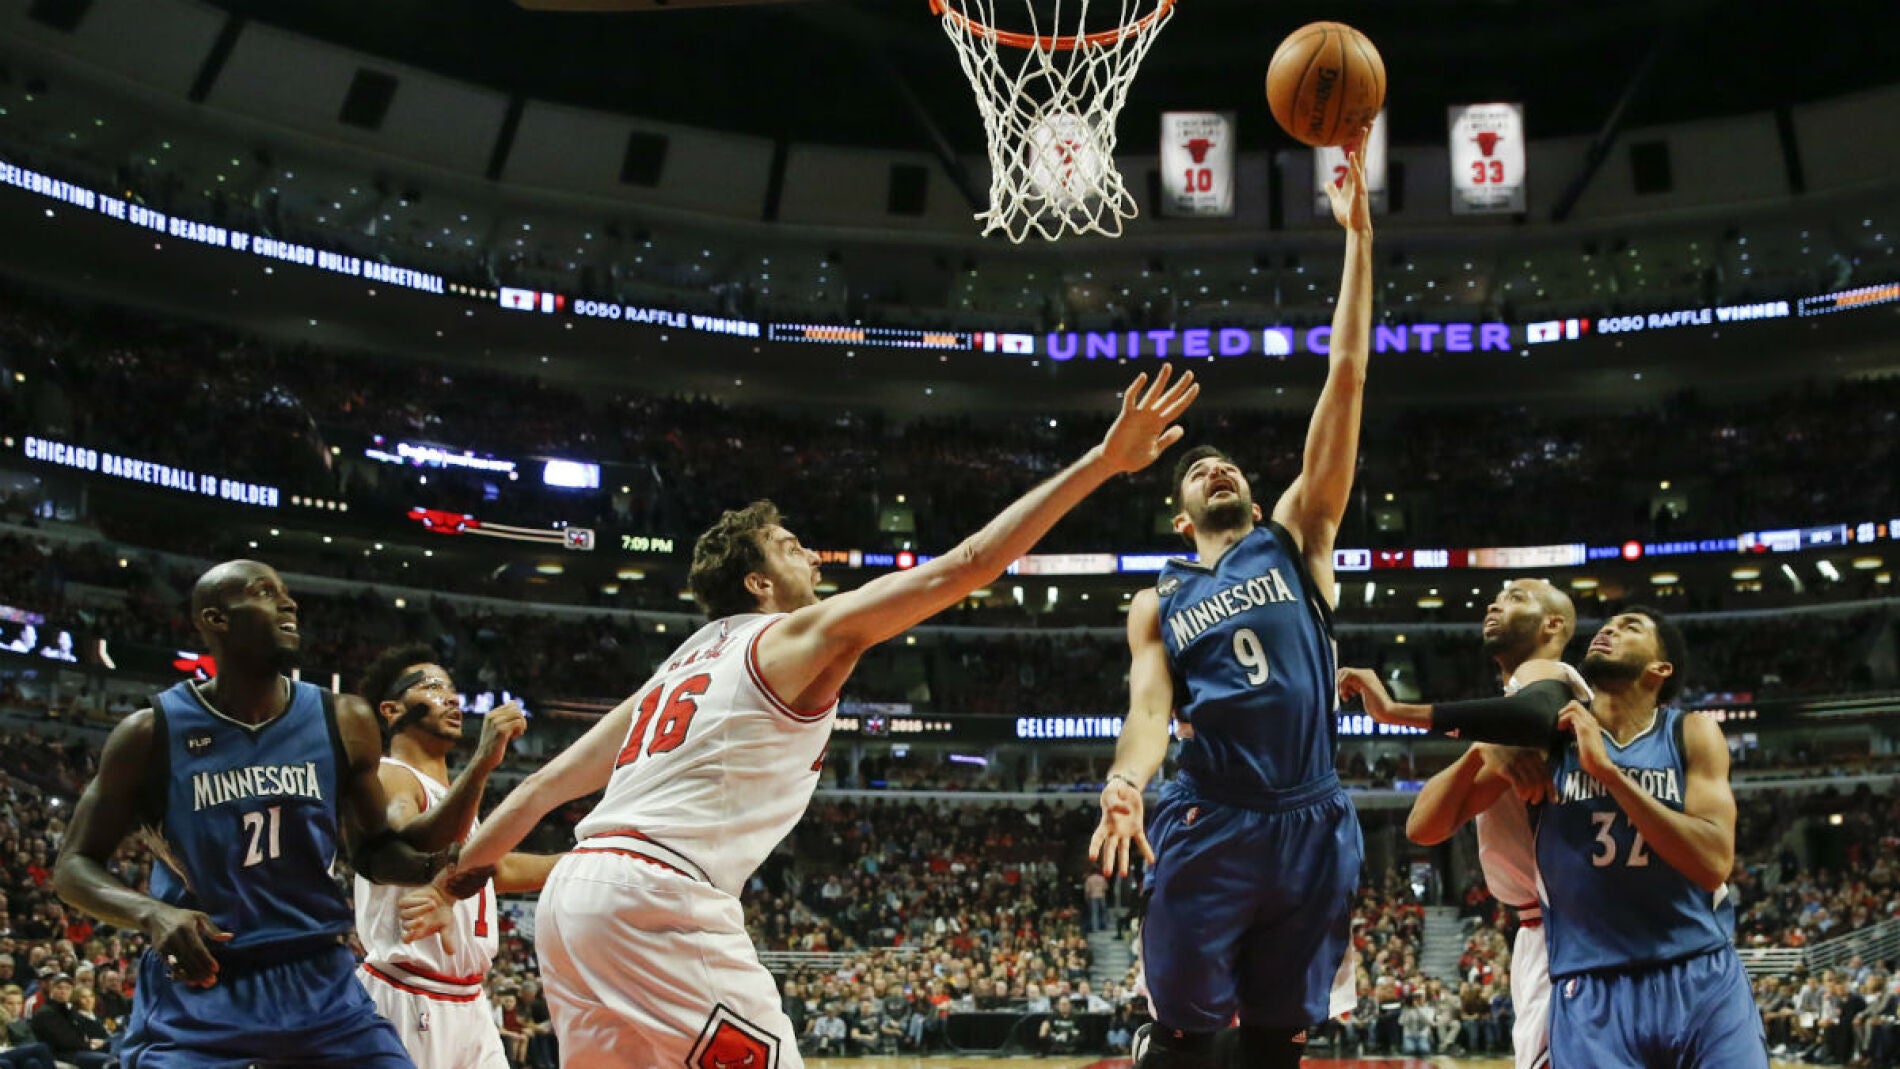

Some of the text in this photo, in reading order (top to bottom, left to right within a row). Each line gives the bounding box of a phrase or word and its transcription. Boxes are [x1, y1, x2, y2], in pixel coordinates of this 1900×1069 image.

[1184, 168, 1212, 193] 10
[1471, 160, 1505, 184] 33
[0, 161, 96, 210] CELEBRATING
[99, 193, 126, 220] THE
[169, 216, 228, 248] SEASON
[231, 230, 249, 251] OF
[252, 235, 315, 266] CHICAGO
[318, 249, 361, 276] BULLS
[363, 260, 445, 294] BASKETBALL
[573, 298, 760, 338] 5050 RAFFLE WINNER
[1598, 300, 1790, 334] 5050 RAFFLE WINNER
[1045, 323, 1512, 361] UNITED CNTER
[24, 436, 279, 508] CHICAGO BASKETBALL IS GOLDEN
[621, 534, 674, 554] 7:09 PM
[1168, 567, 1299, 651] MINNESOTA
[1232, 627, 1270, 687] 9
[615, 672, 713, 771] 16
[1016, 716, 1123, 738] CELEBRATING
[189, 736, 213, 749] FLIP
[192, 761, 322, 812] MINNESOTA
[243, 805, 282, 867] 21
